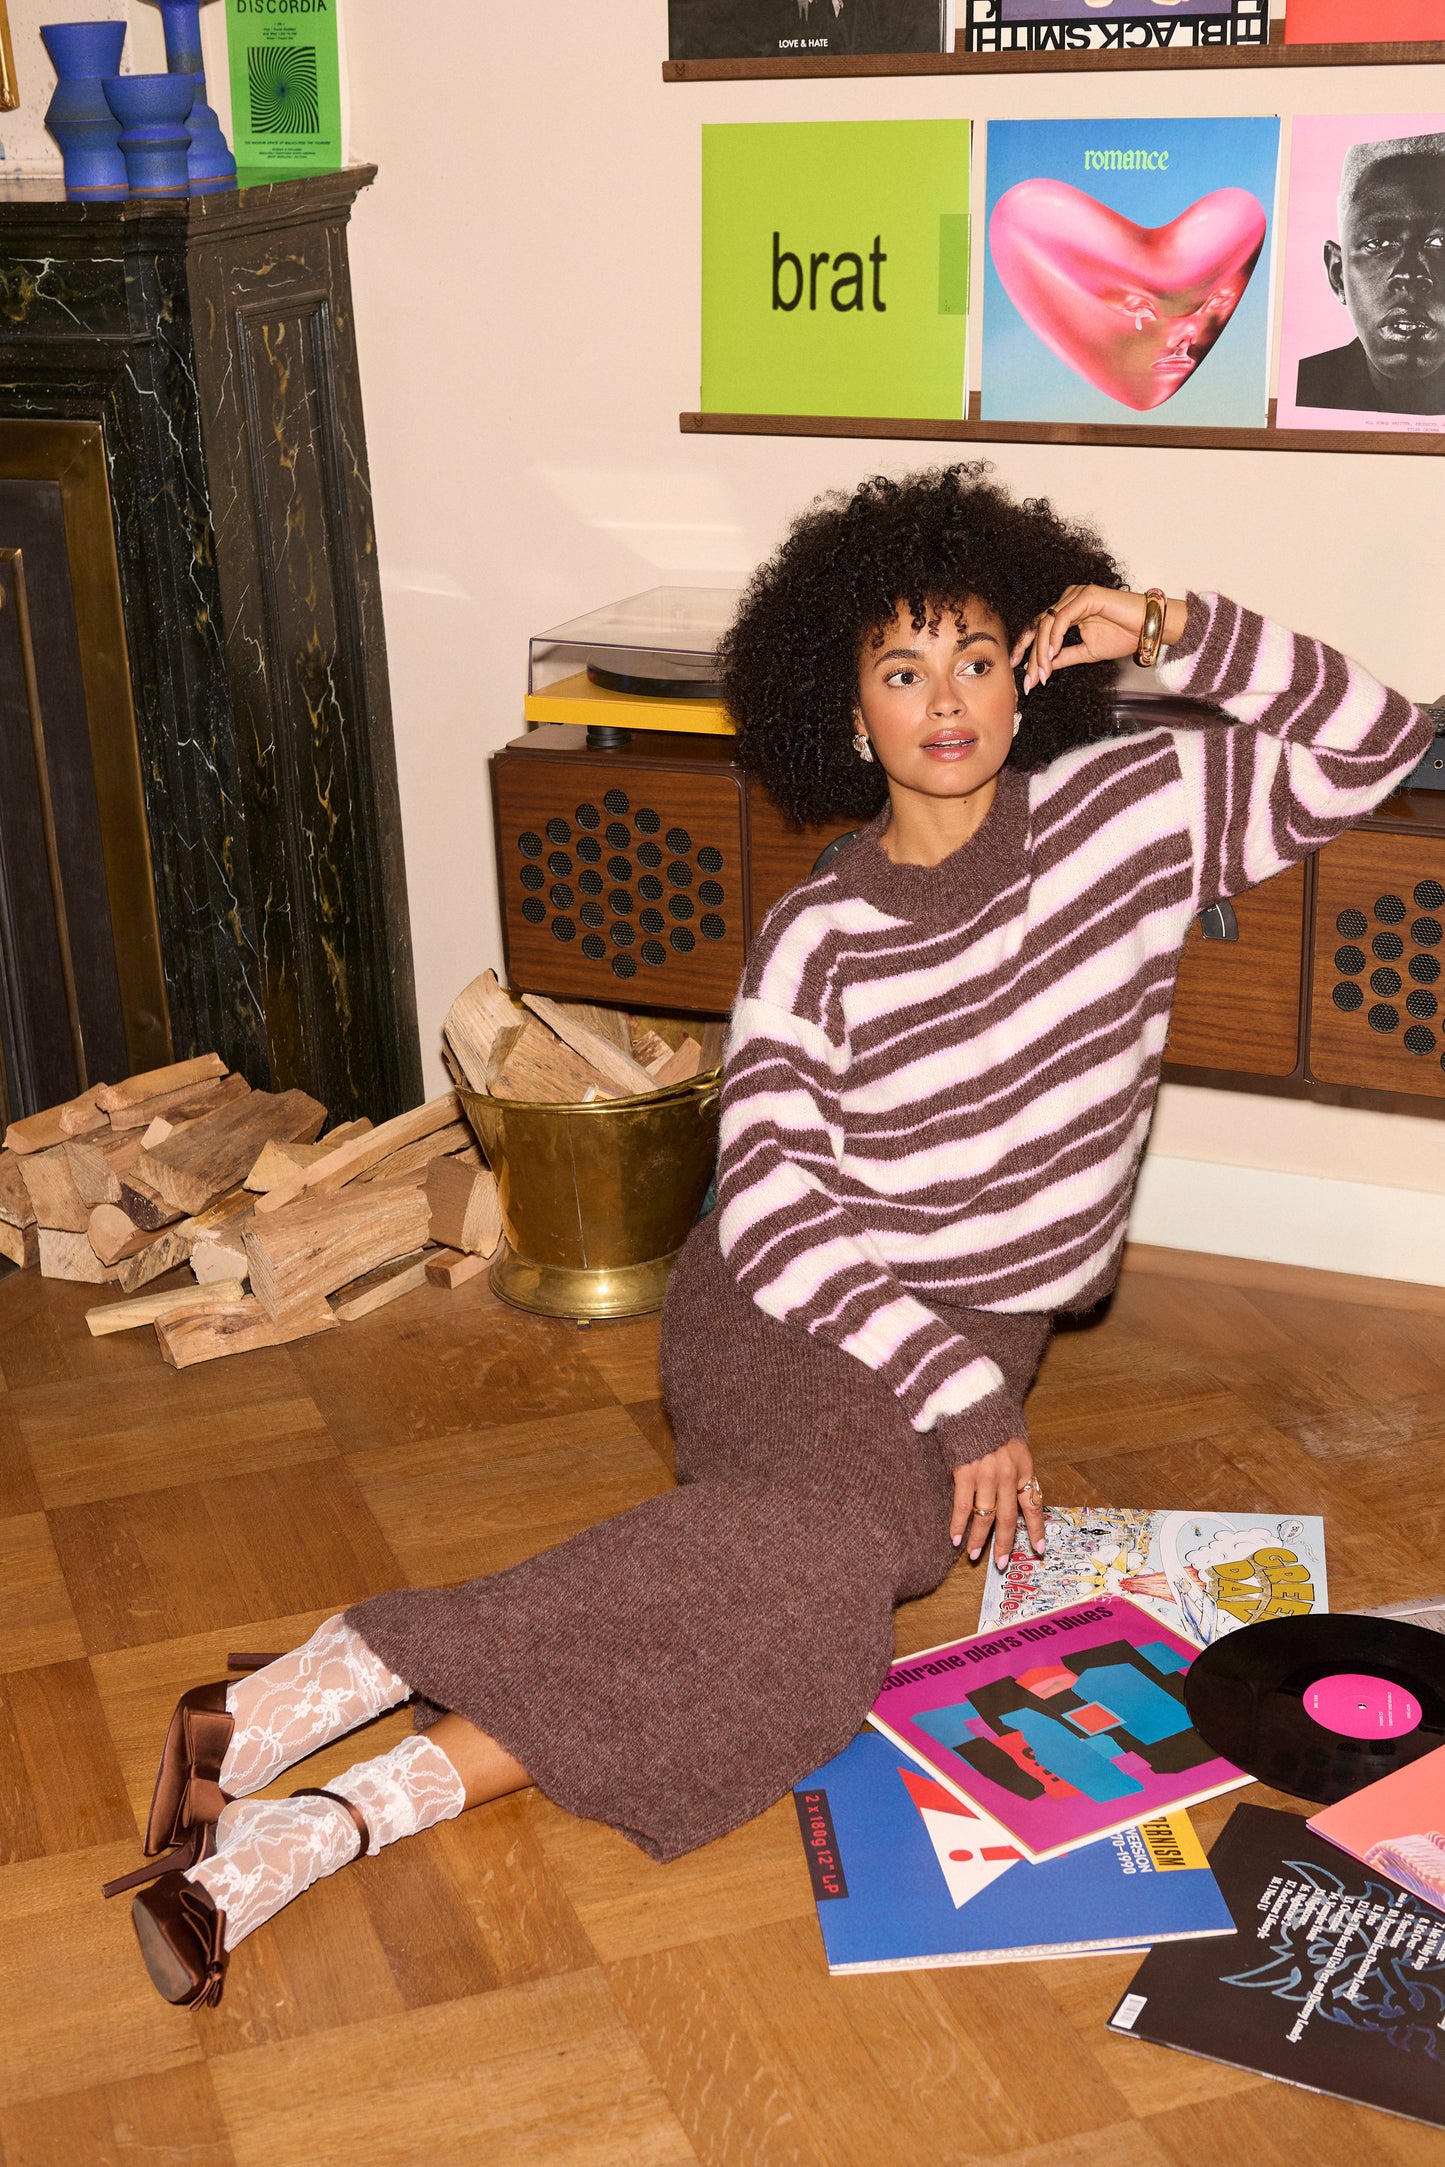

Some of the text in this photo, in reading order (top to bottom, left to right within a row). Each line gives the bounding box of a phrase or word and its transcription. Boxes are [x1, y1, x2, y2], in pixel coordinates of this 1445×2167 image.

[237, 0, 327, 14] DISCORDIA
[779, 38, 829, 49] LOVE & HATE
[1084, 149, 1169, 171] romance
[772, 231, 887, 312] brat
[1000, 1551, 1041, 1613] dookie
[1212, 1559, 1264, 1625] DAY
[1250, 1546, 1316, 1625] GREE
[881, 1606, 1114, 1692] coltrane plays the blues
[805, 1795, 820, 1803] 2
[810, 1816, 828, 1847] 180g
[1125, 1826, 1153, 1873] VERSION
[1109, 1834, 1137, 1875] 70-1990
[822, 1874, 840, 1894] LP
